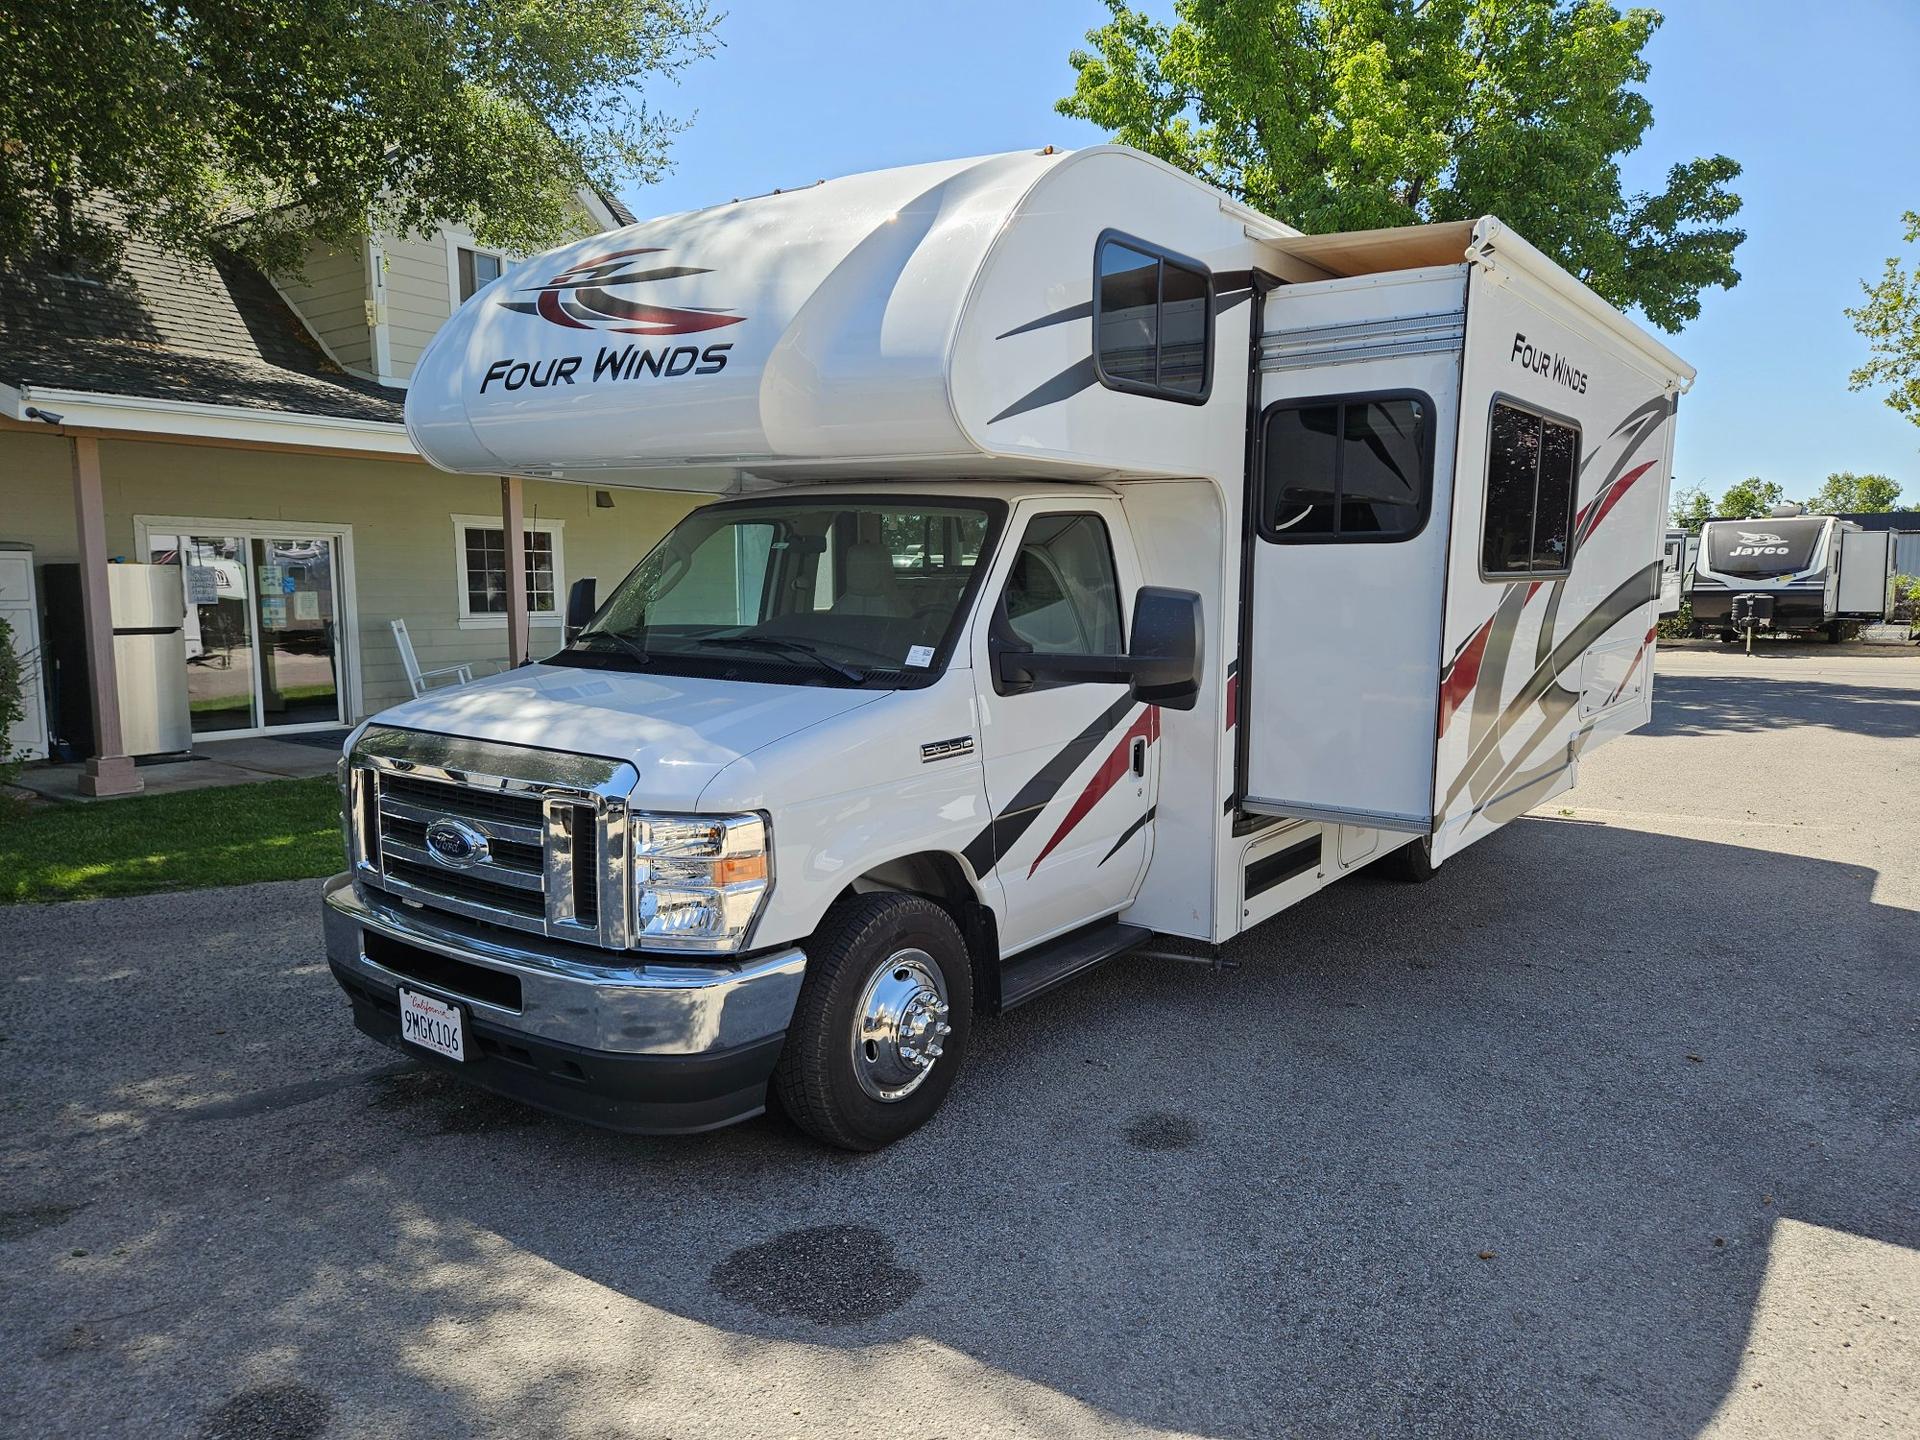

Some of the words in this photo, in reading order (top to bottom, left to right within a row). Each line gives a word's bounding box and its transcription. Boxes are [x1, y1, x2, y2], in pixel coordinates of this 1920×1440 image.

[480, 356, 583, 394] FOUR
[592, 343, 734, 383] WINDS
[1511, 332, 1551, 378] FOUR
[1552, 353, 1588, 394] WINDS
[1729, 546, 1790, 557] Jayco
[431, 832, 460, 863] Ford
[412, 996, 450, 1019] California
[405, 1010, 459, 1052] 9MGK106
